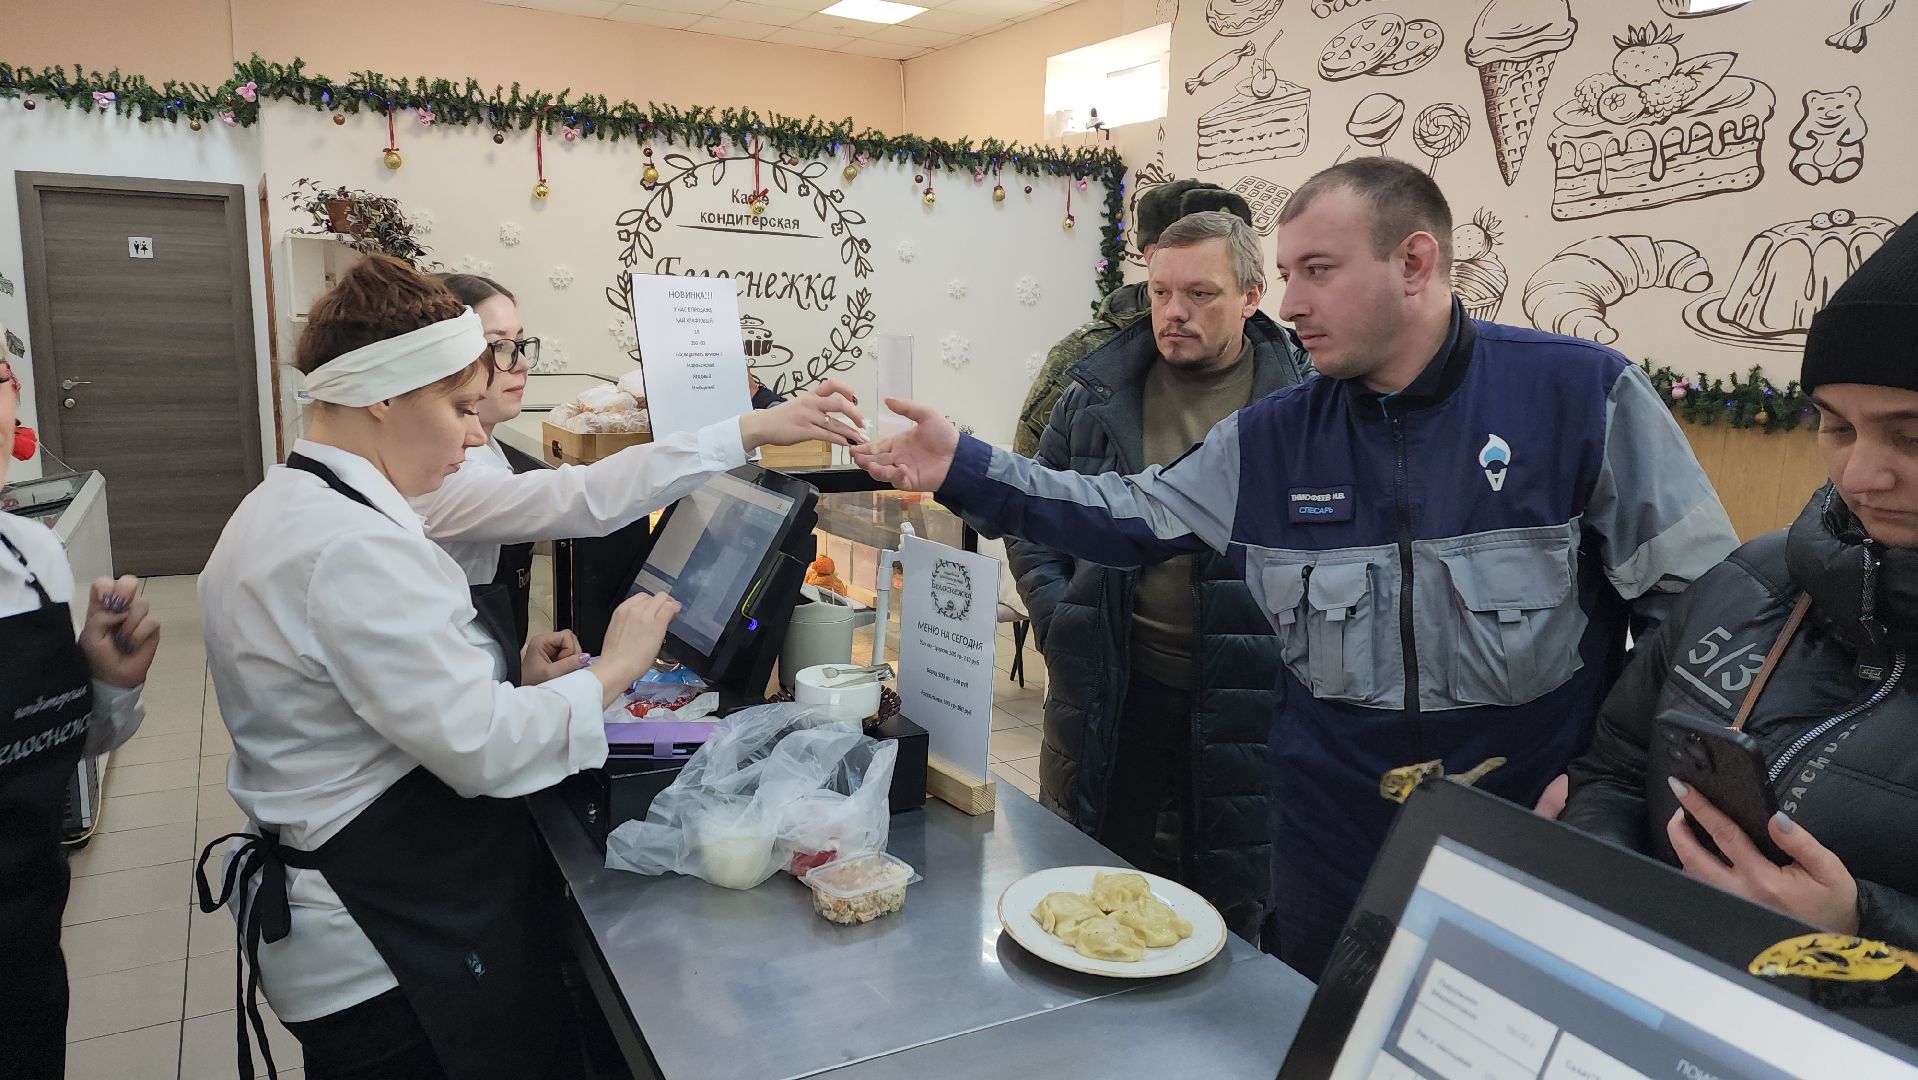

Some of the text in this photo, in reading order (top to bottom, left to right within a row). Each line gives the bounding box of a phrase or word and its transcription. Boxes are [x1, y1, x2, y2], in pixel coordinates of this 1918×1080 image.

[731, 188, 770, 206] Кае
[699, 211, 800, 230] кондитерская
[1299, 506, 1334, 514] СЛЕСАРЬ
[917, 620, 984, 652] МЕНЮ НА СЕГОДНЯ
